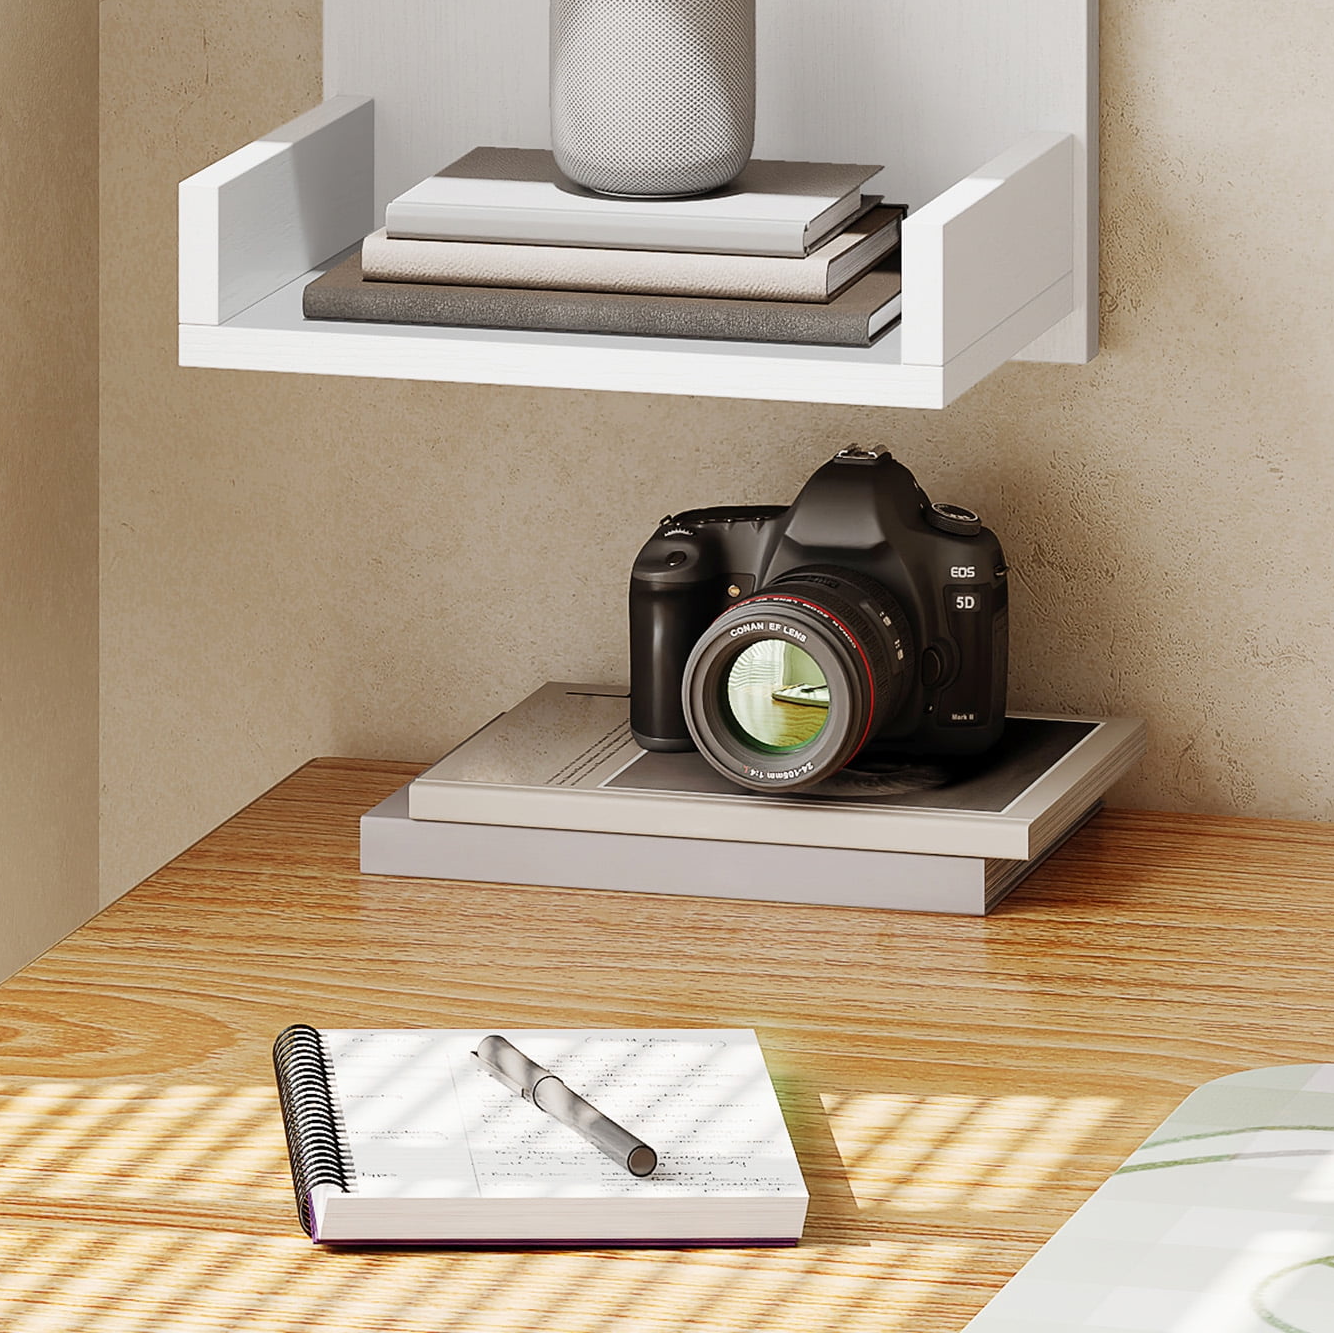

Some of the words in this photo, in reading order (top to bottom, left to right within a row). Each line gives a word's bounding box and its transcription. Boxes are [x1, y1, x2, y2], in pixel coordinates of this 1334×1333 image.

[950, 566, 976, 579] EOS
[956, 596, 975, 609] 5D
[729, 622, 765, 638] CONAN
[768, 622, 782, 632] EF
[783, 626, 808, 643] LENS
